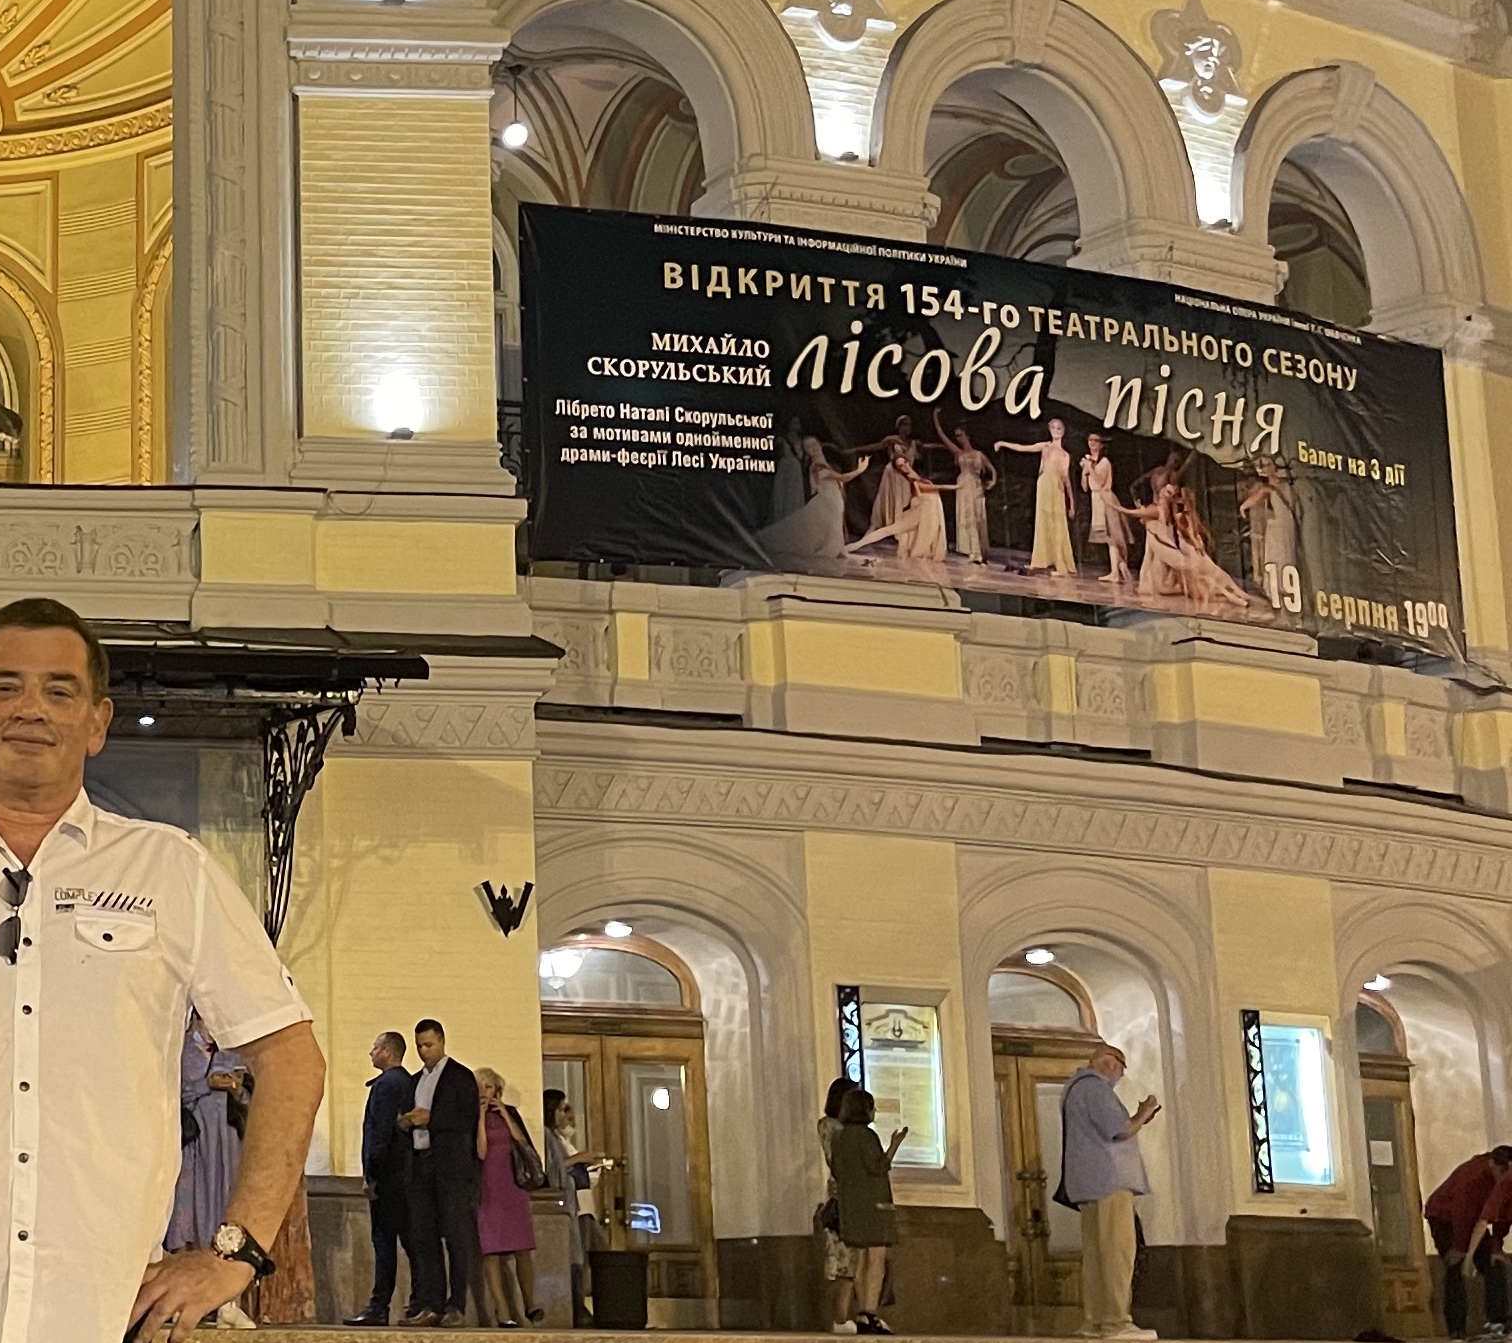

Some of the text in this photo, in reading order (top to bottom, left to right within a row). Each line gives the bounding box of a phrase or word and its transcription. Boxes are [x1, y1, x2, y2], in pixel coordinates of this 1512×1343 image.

[654, 223, 729, 239] МІНІСТЕРСТВО
[731, 228, 782, 244] КУЛЬТУРИ
[784, 234, 796, 246] ТА
[663, 261, 886, 311] ВІДКРИТТЯ
[1028, 305, 1253, 368] ТЕАТРАЛЬНОГО
[1263, 348, 1358, 392] СЕЗОНУ
[650, 332, 771, 359] МИХАЙЛО
[587, 356, 772, 387] СКОРУЛЬСЬКИЙ
[787, 320, 1284, 455] лісова пісня
[555, 398, 774, 429] Лібрето Наталі Скорульської
[569, 425, 775, 452] за мотивами однойменної
[560, 447, 776, 474] драми-феєрії Лесі Українки
[1297, 441, 1406, 486] Балет на 3 дії
[1264, 562, 1303, 613] 19
[1315, 590, 1400, 633] серпня
